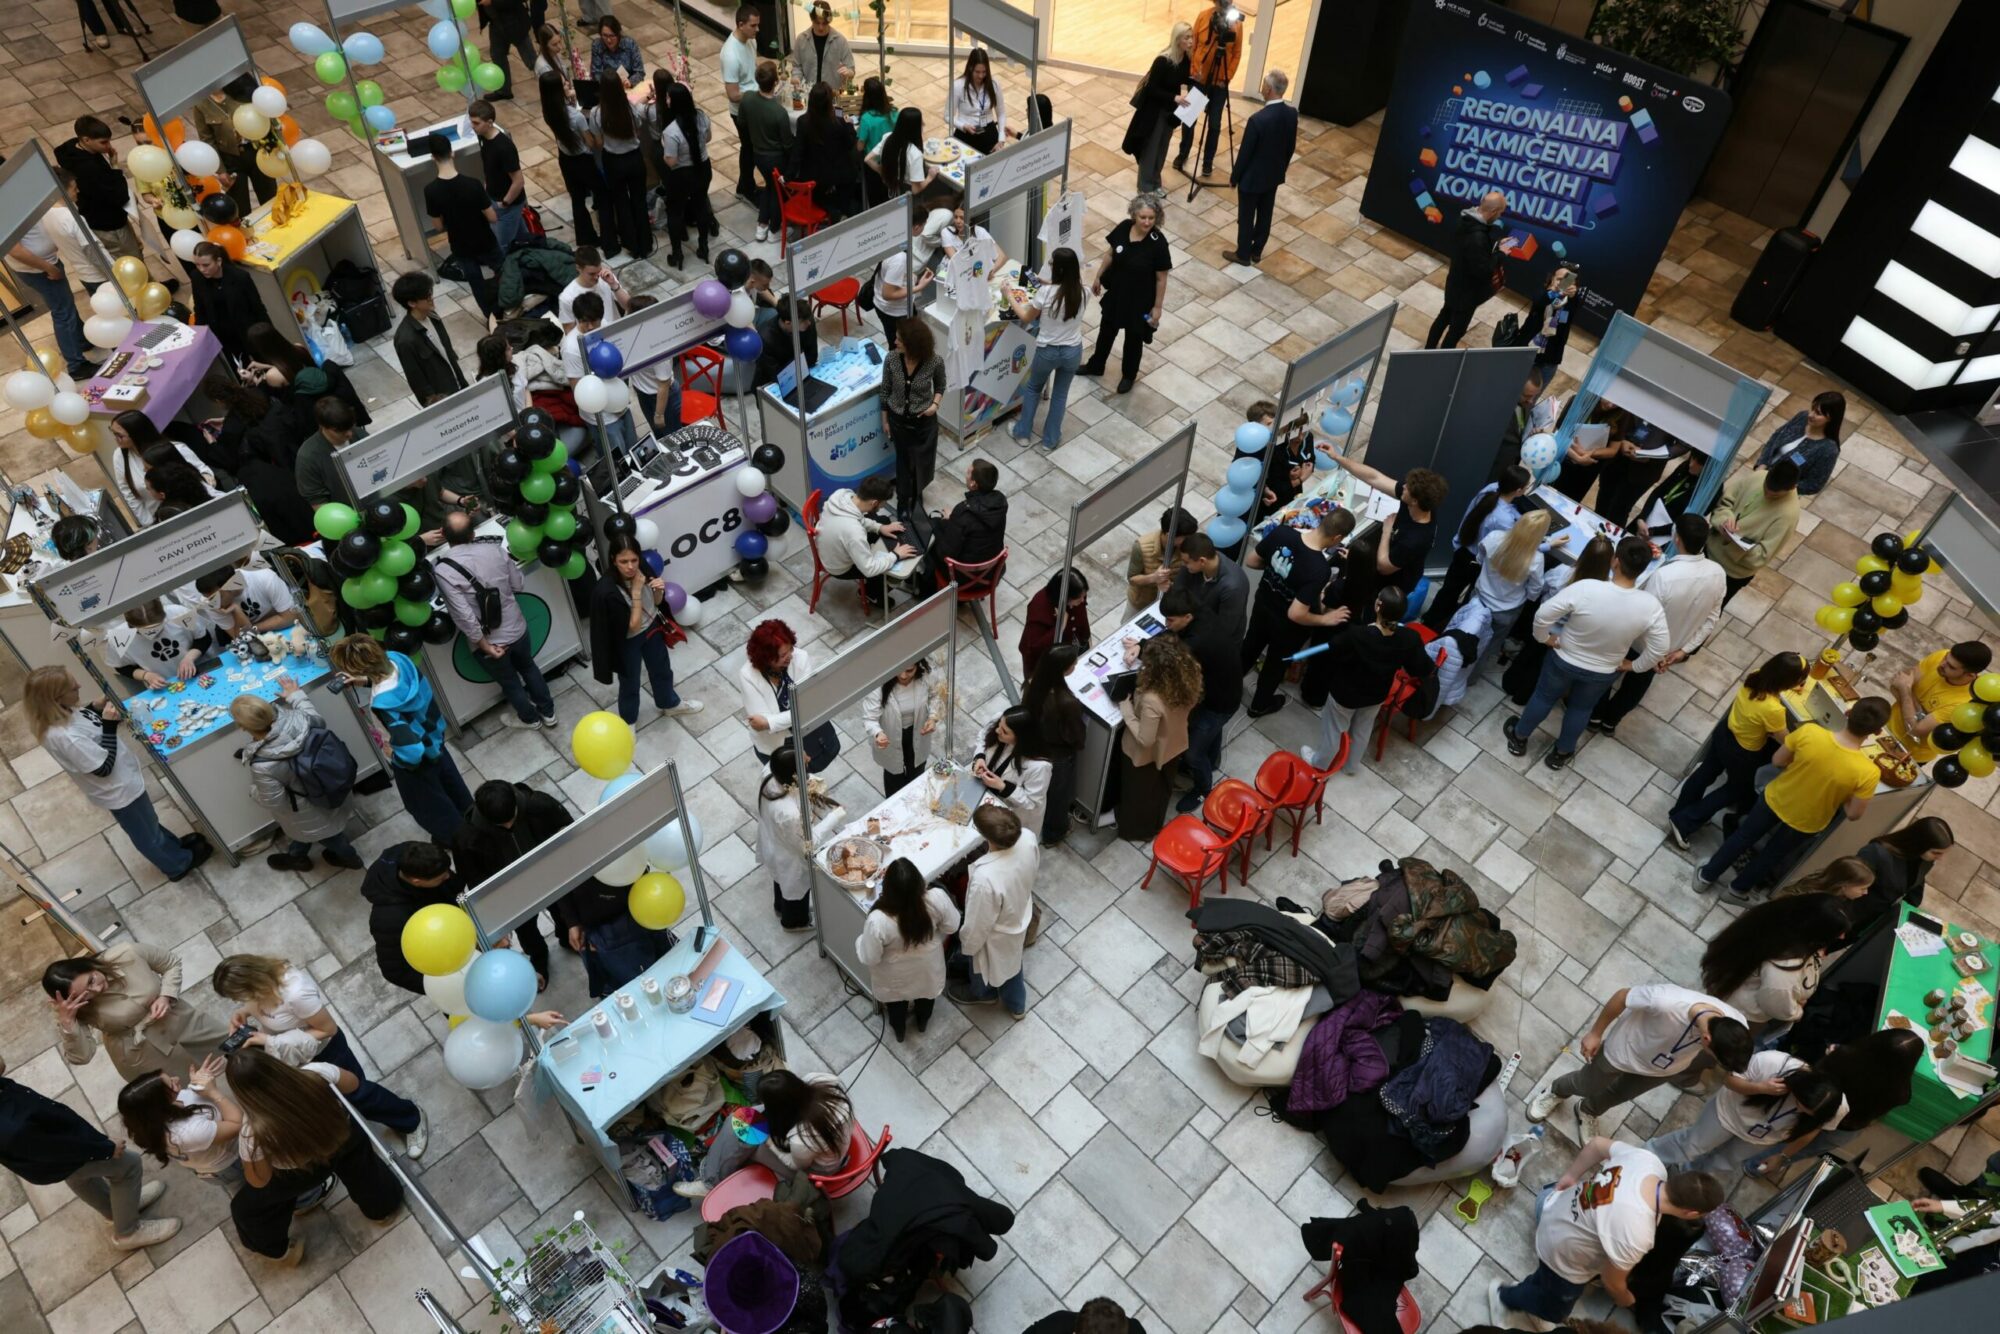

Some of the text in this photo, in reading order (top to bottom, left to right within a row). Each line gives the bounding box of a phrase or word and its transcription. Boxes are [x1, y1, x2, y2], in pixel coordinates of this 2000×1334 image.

[1622, 72, 1647, 88] BOOST
[1460, 97, 1618, 148] REGIONALNA
[1445, 148, 1582, 198] UČENIČKIH
[1454, 122, 1611, 175] TAKMIČENJA
[440, 414, 480, 438] MasterMe
[158, 531, 217, 563] PAW PRINT
[664, 507, 742, 566] OC8
